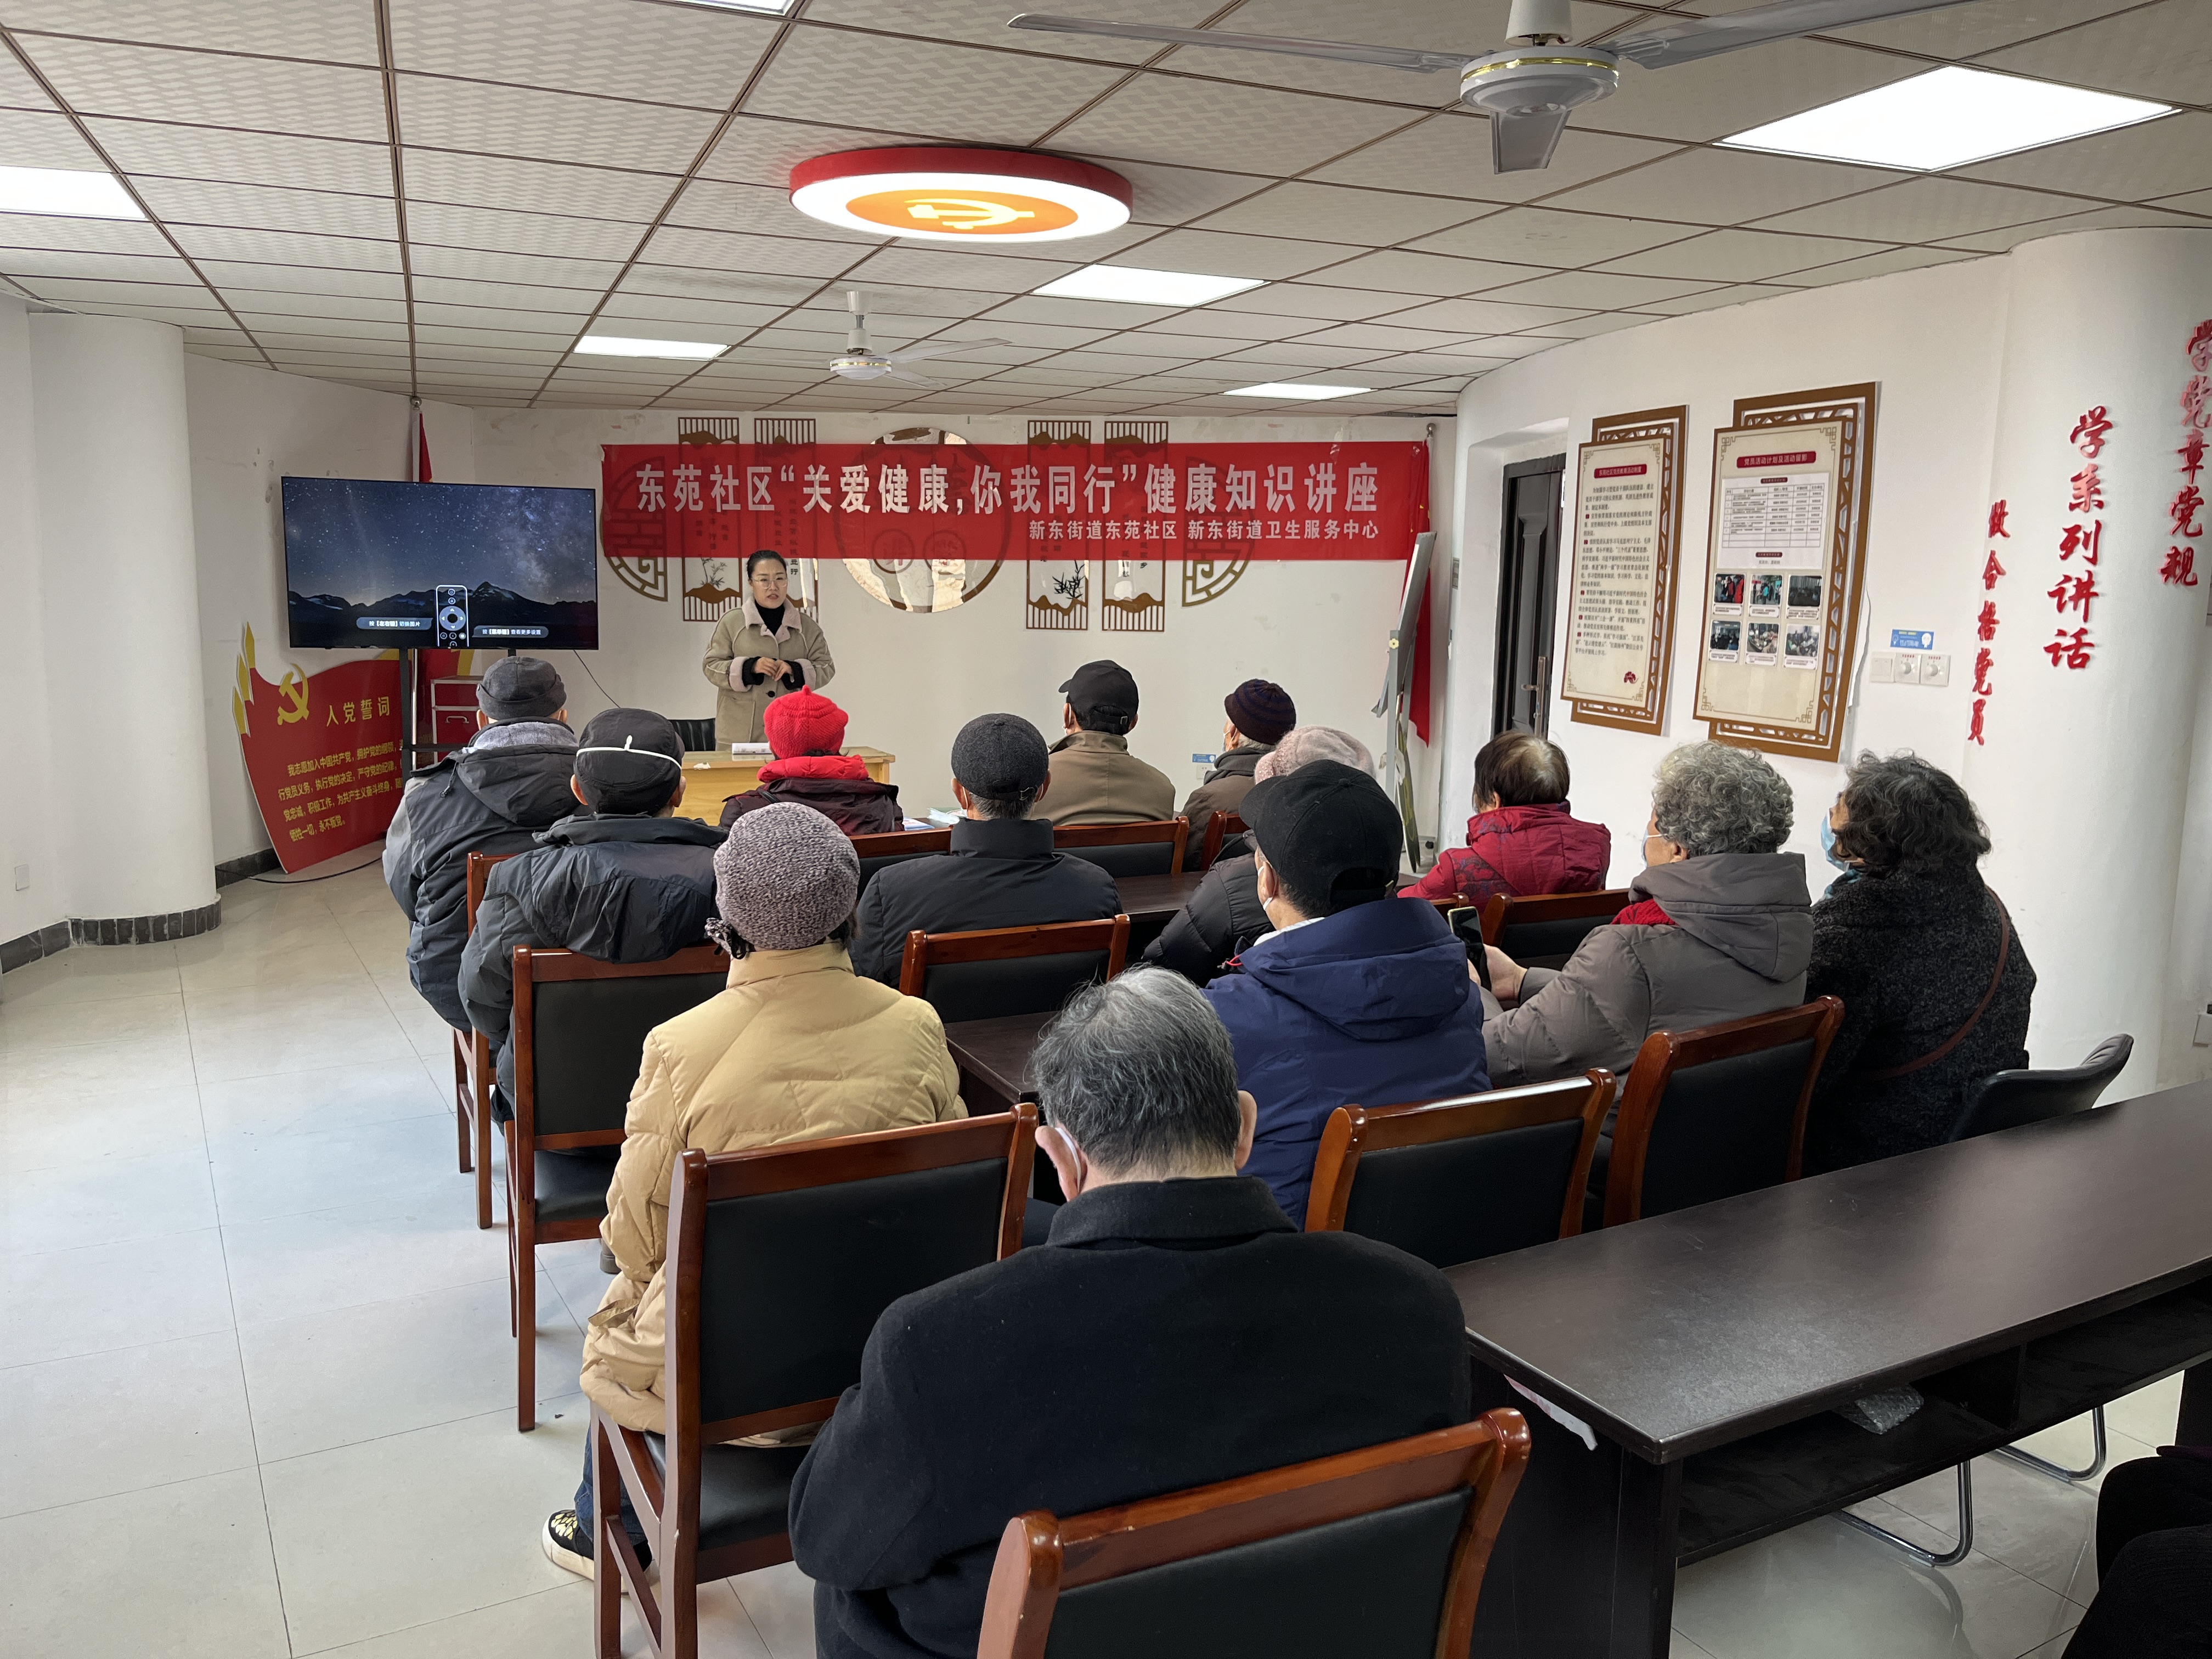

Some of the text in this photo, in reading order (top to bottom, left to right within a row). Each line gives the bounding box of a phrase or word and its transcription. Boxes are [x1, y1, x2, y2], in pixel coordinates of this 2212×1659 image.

[1029, 520, 1177, 540] 新东街道东苑社区
[1188, 519, 1379, 540] 新东街道卫生服务中心
[1967, 499, 2011, 746] 做合格党员
[2043, 405, 2113, 670] 学系列讲话
